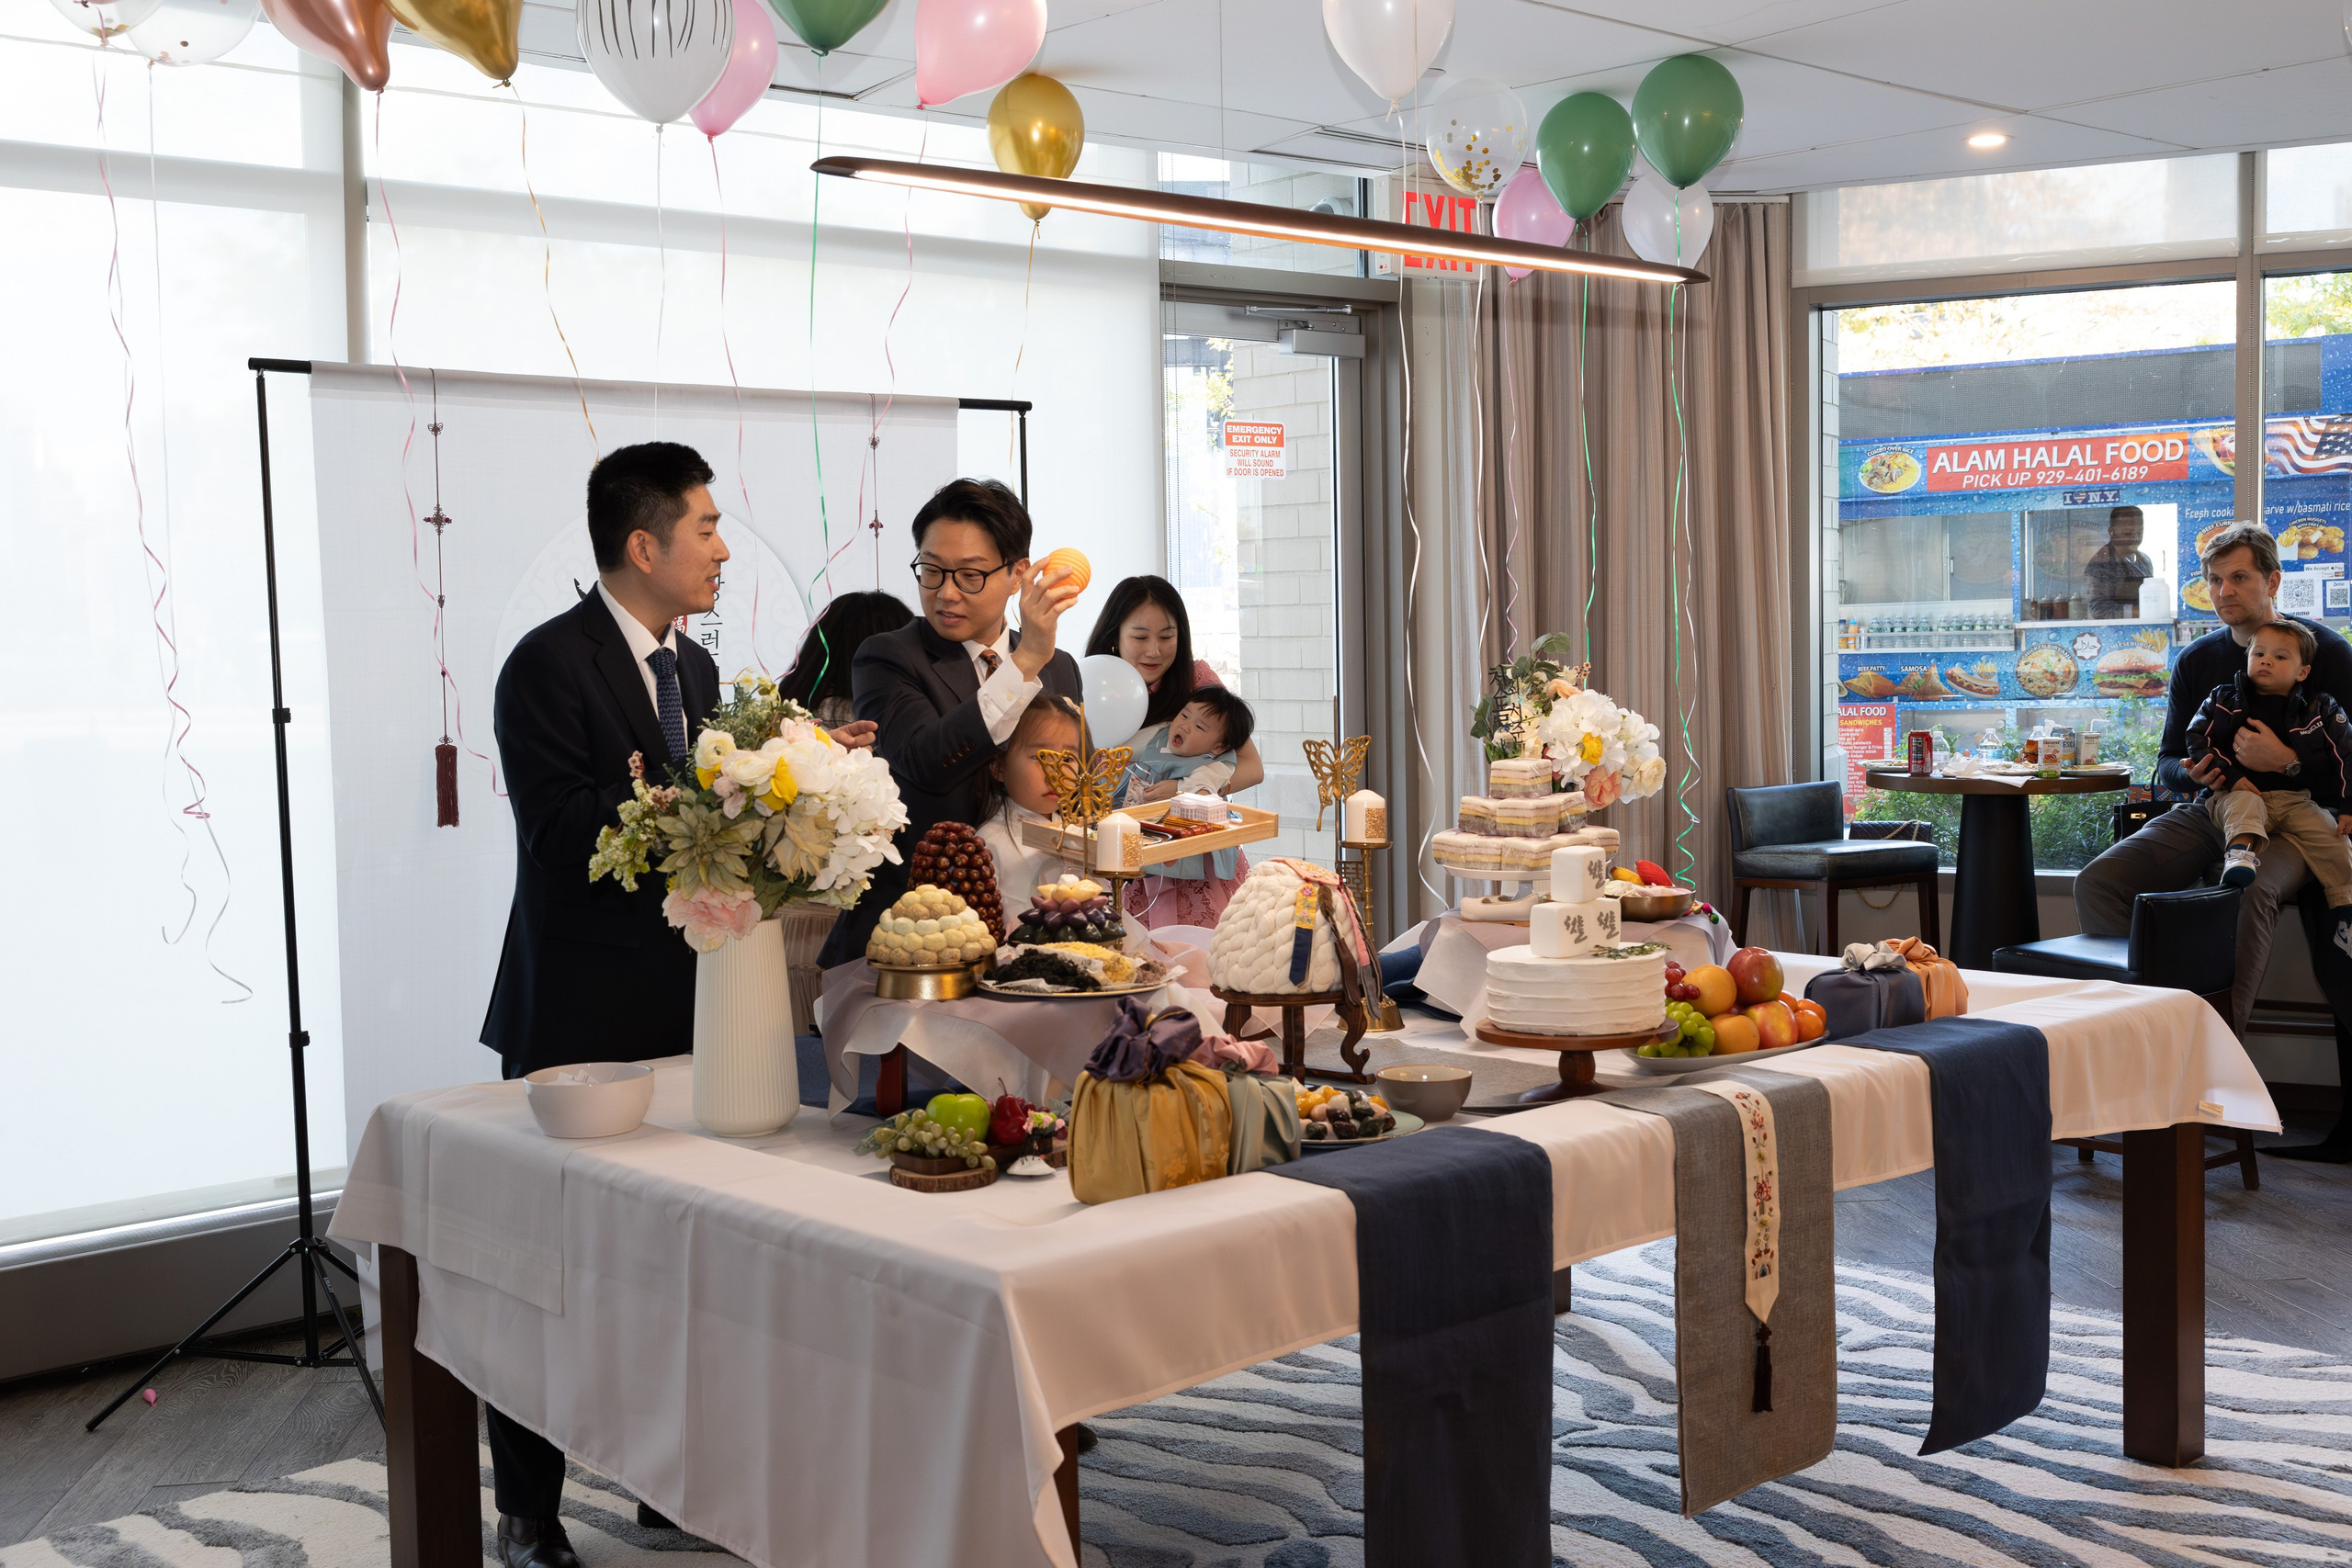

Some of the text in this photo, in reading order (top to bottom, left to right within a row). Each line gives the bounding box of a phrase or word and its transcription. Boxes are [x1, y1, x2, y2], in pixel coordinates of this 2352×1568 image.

[1402, 191, 1476, 273] EXIT
[1227, 425, 1283, 434] EMERGENCY
[1232, 434, 1277, 444] EXIT ONLY
[1229, 449, 1259, 457] SECURITY
[1867, 446, 1886, 457] COMBO
[1932, 439, 2184, 474] ALAM HALAL FOOD
[1260, 468, 1284, 477] OPENED
[1962, 466, 2149, 488] PICK UP 929-401-6189
[2064, 491, 2120, 504] I N.Y.
[2185, 507, 2209, 518] Fresh
[2211, 506, 2234, 517] cooki
[2287, 501, 2332, 515] w/basmati
[2334, 502, 2350, 511] rice
[2289, 518, 2306, 526] CHICKEN
[2201, 522, 2215, 535] BEEF
[2106, 641, 2156, 651] CHEESEBURGER
[2022, 644, 2073, 662] CHICKEN BIRYANI
[1838, 706, 1886, 716] ALAL FOOD
